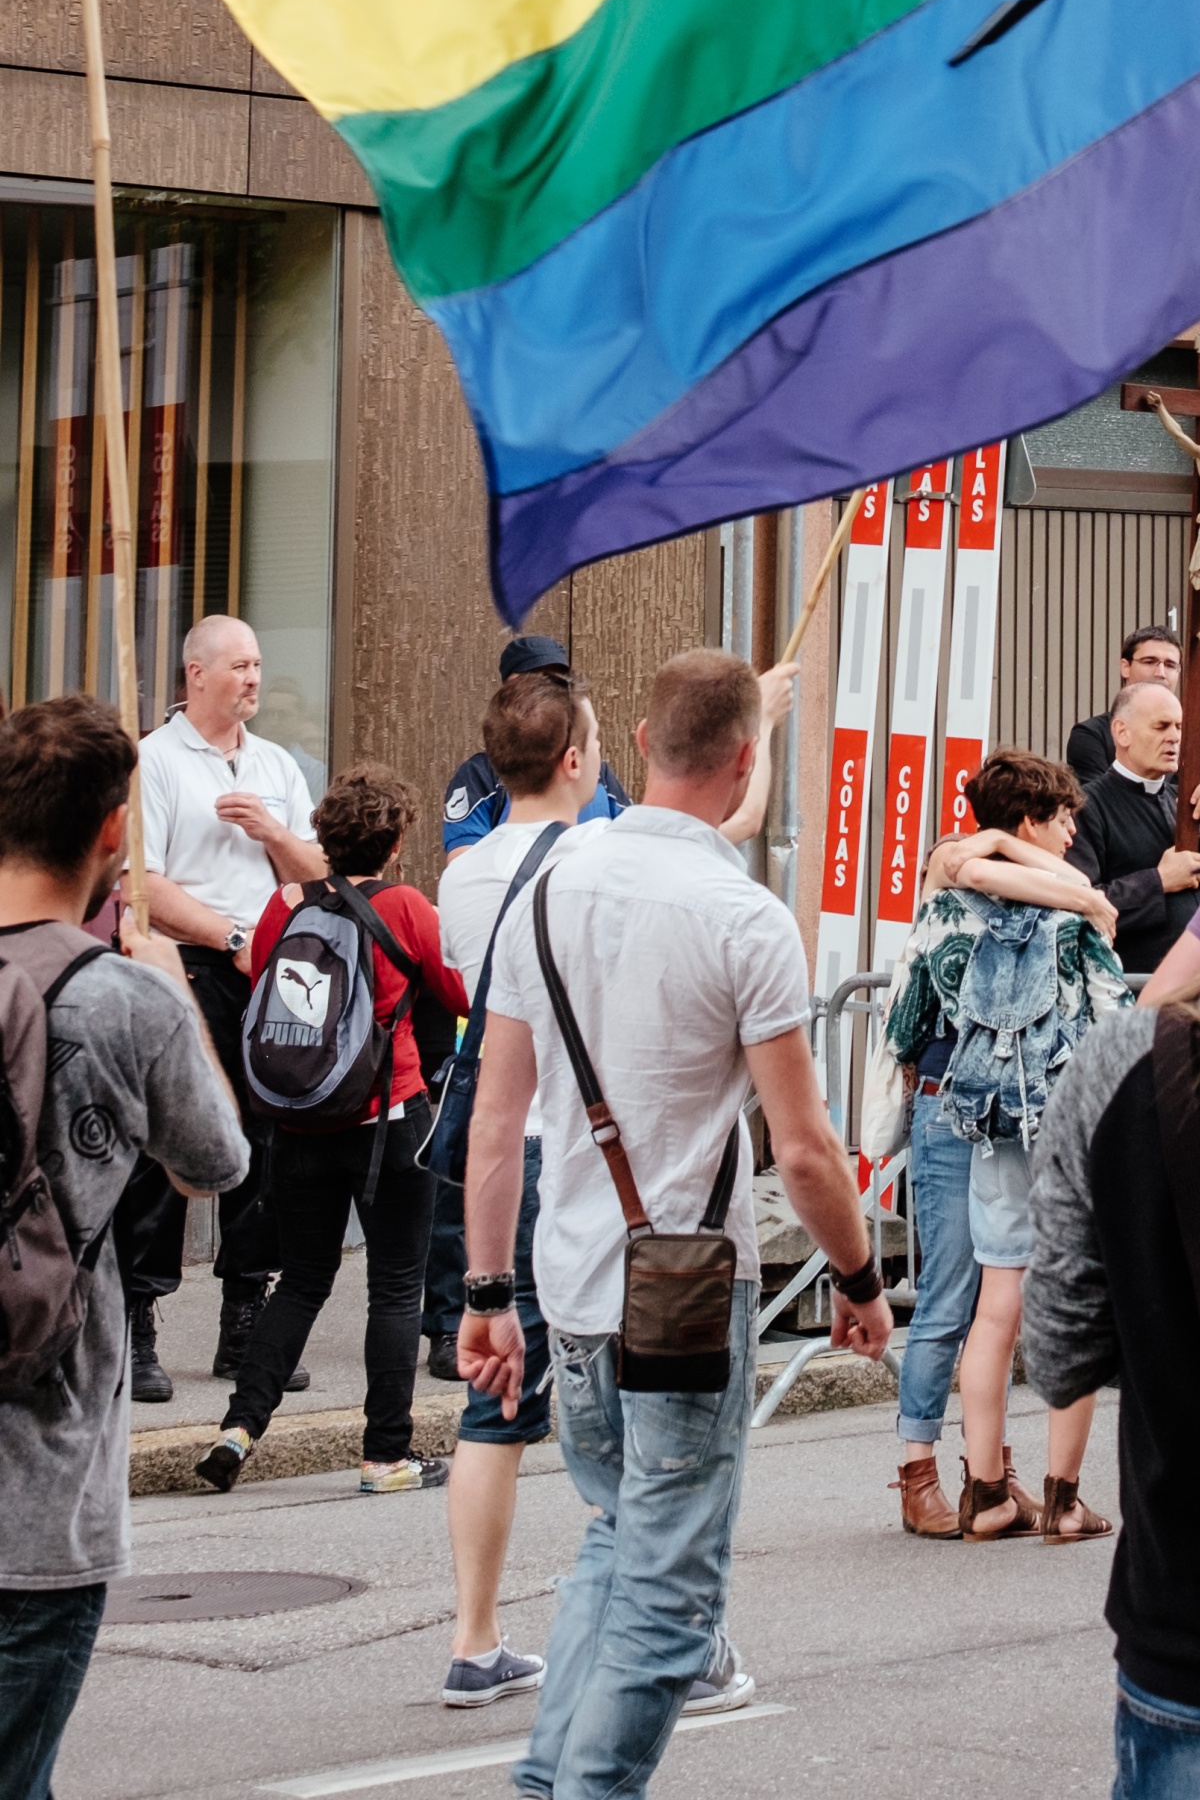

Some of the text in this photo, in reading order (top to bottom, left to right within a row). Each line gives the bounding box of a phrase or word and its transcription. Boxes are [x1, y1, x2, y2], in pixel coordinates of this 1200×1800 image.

[971, 447, 986, 523] LAS
[834, 759, 855, 887] COLAS
[890, 765, 912, 895] COLAS
[260, 1022, 323, 1047] PUMA
